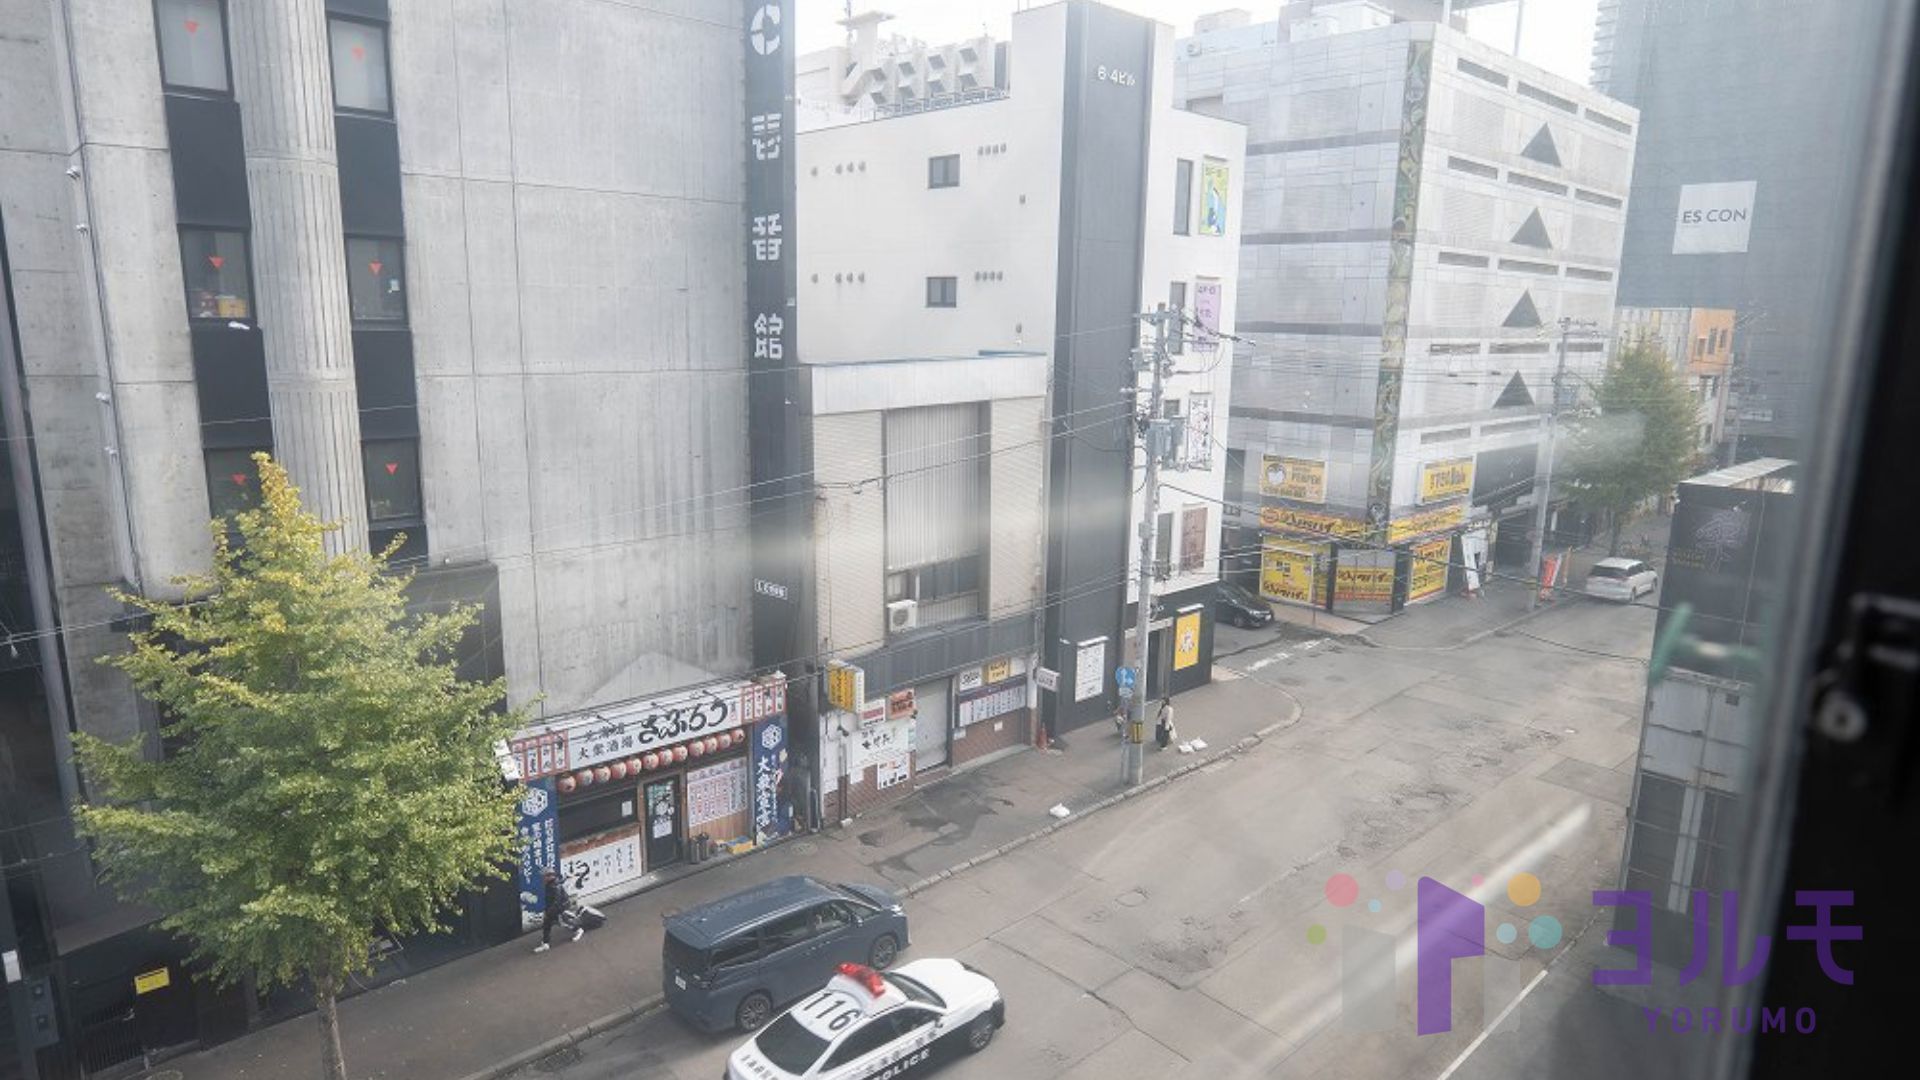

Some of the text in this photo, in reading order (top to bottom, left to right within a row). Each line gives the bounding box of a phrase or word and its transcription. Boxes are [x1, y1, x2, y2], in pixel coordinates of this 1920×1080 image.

[1683, 208, 1747, 223] ES CON
[638, 699, 729, 744] さぶろう
[803, 993, 862, 1031] 116
